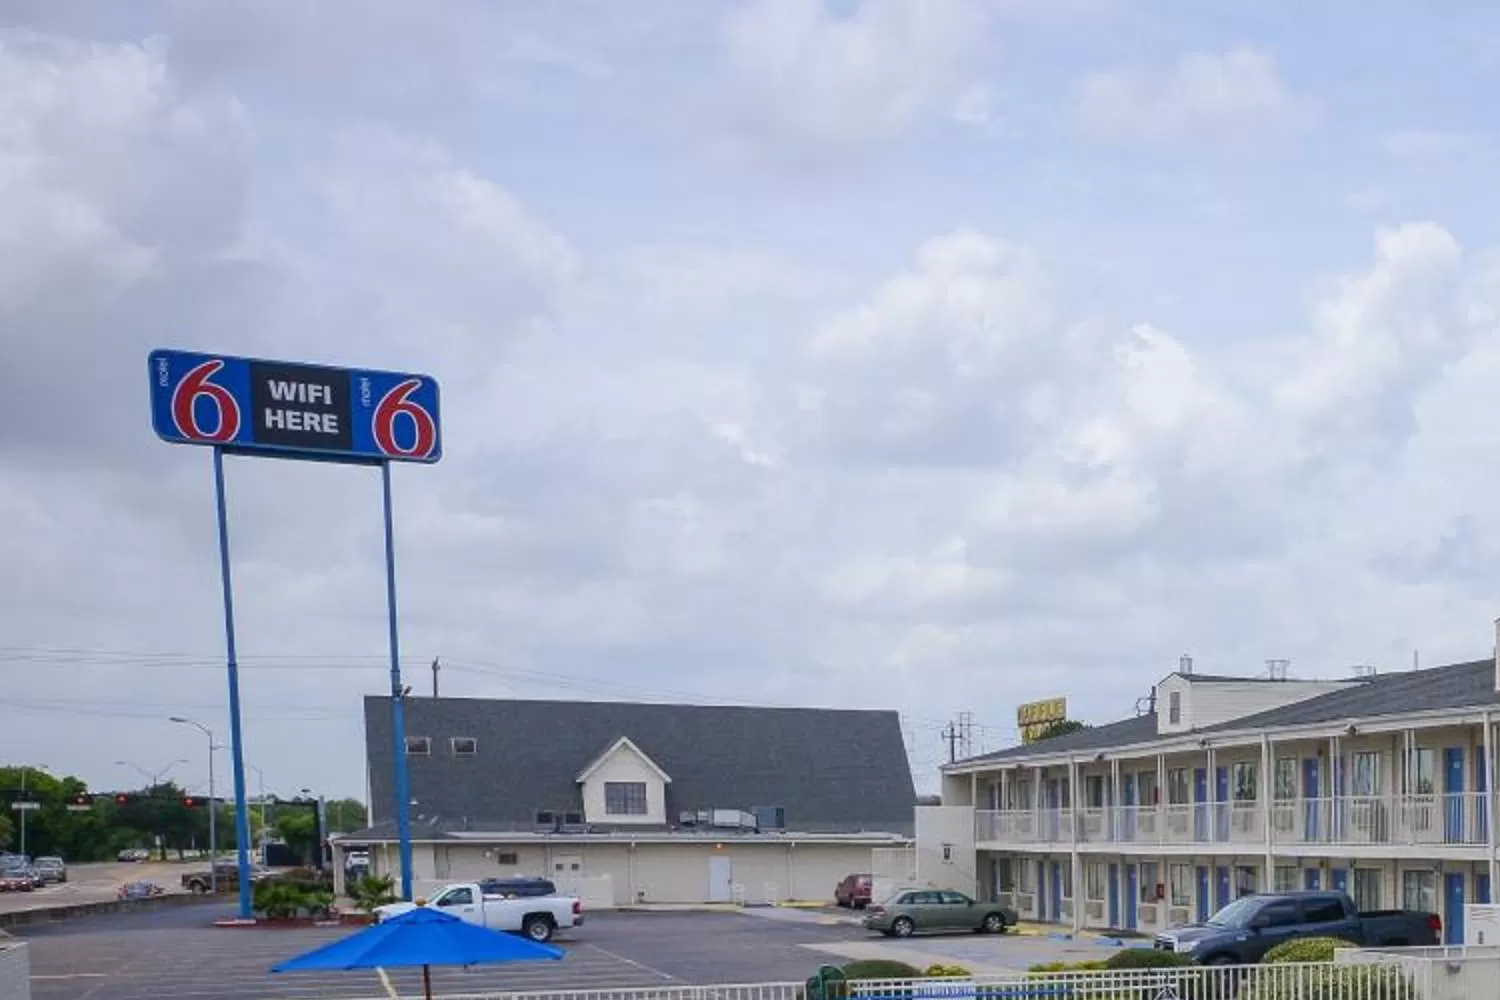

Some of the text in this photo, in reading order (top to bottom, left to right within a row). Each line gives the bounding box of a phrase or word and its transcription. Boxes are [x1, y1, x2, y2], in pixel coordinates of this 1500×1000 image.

[171, 359, 241, 443] 6
[266, 379, 332, 405] WIFI
[264, 408, 340, 434] HERE
[371, 379, 437, 459] 6
